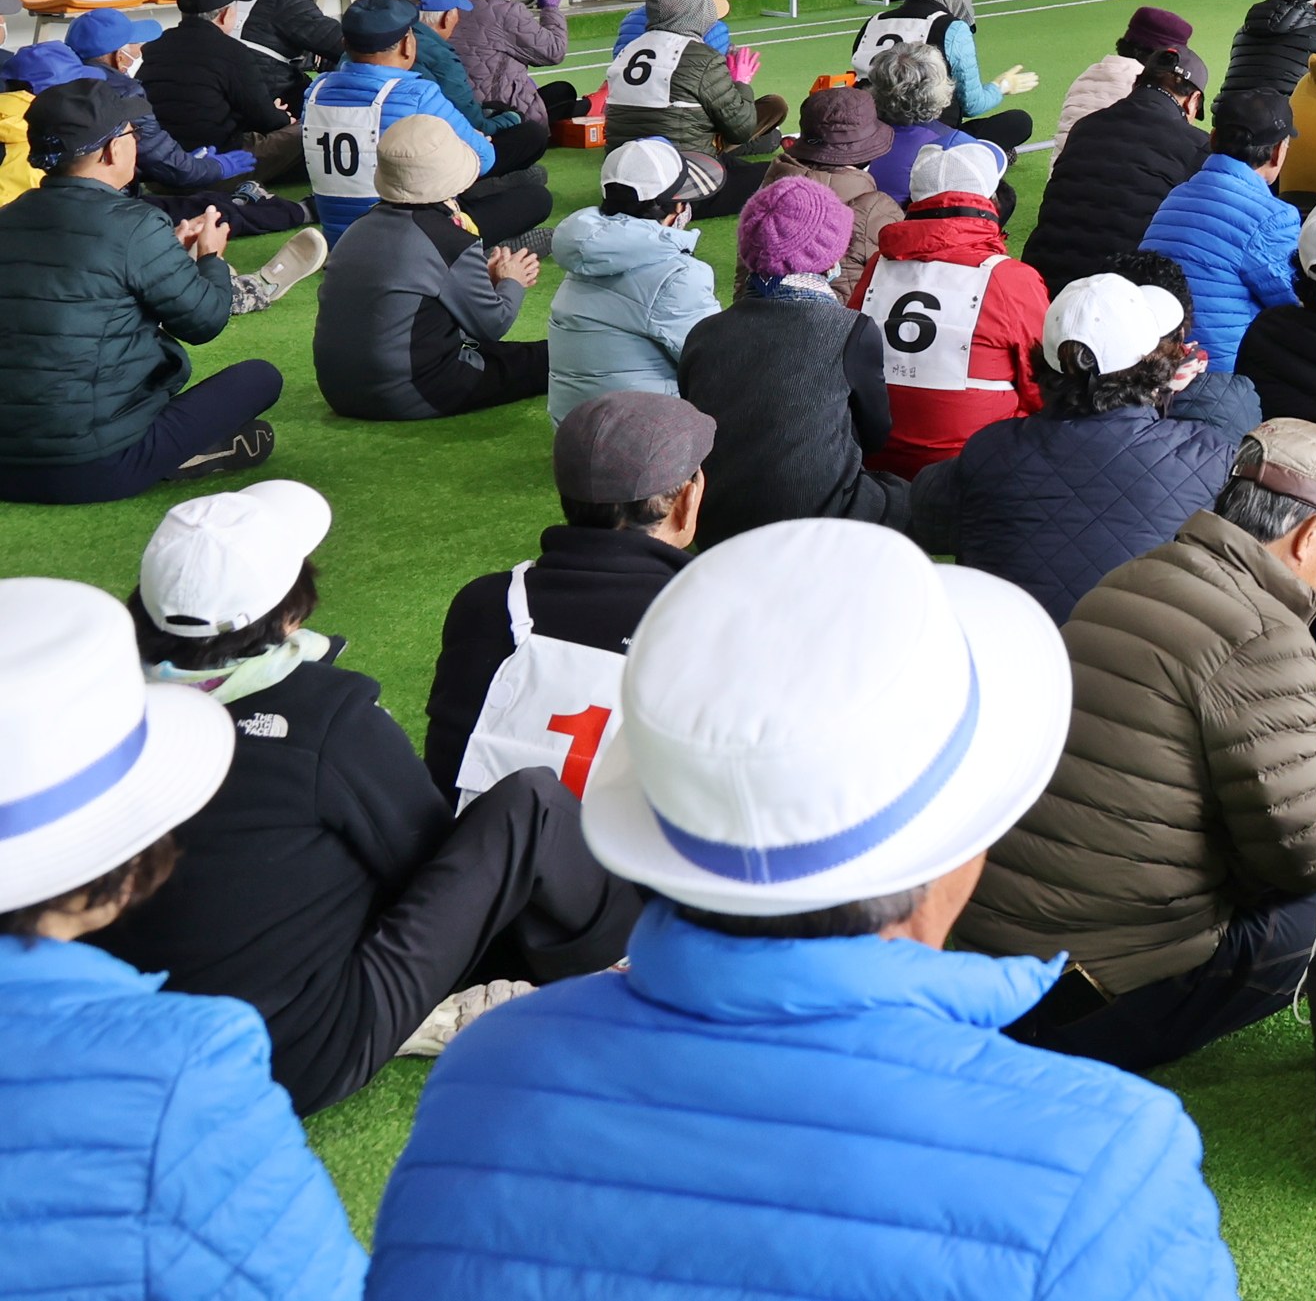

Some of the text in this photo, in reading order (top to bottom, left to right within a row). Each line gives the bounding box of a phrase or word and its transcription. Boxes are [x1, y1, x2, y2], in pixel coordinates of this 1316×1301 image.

[623, 49, 656, 86] 6
[316, 132, 359, 177] 10
[883, 290, 942, 354] 6
[236, 719, 272, 731] NORTH
[244, 726, 270, 738] FACE
[253, 712, 274, 722] THE
[546, 704, 612, 803] 1
